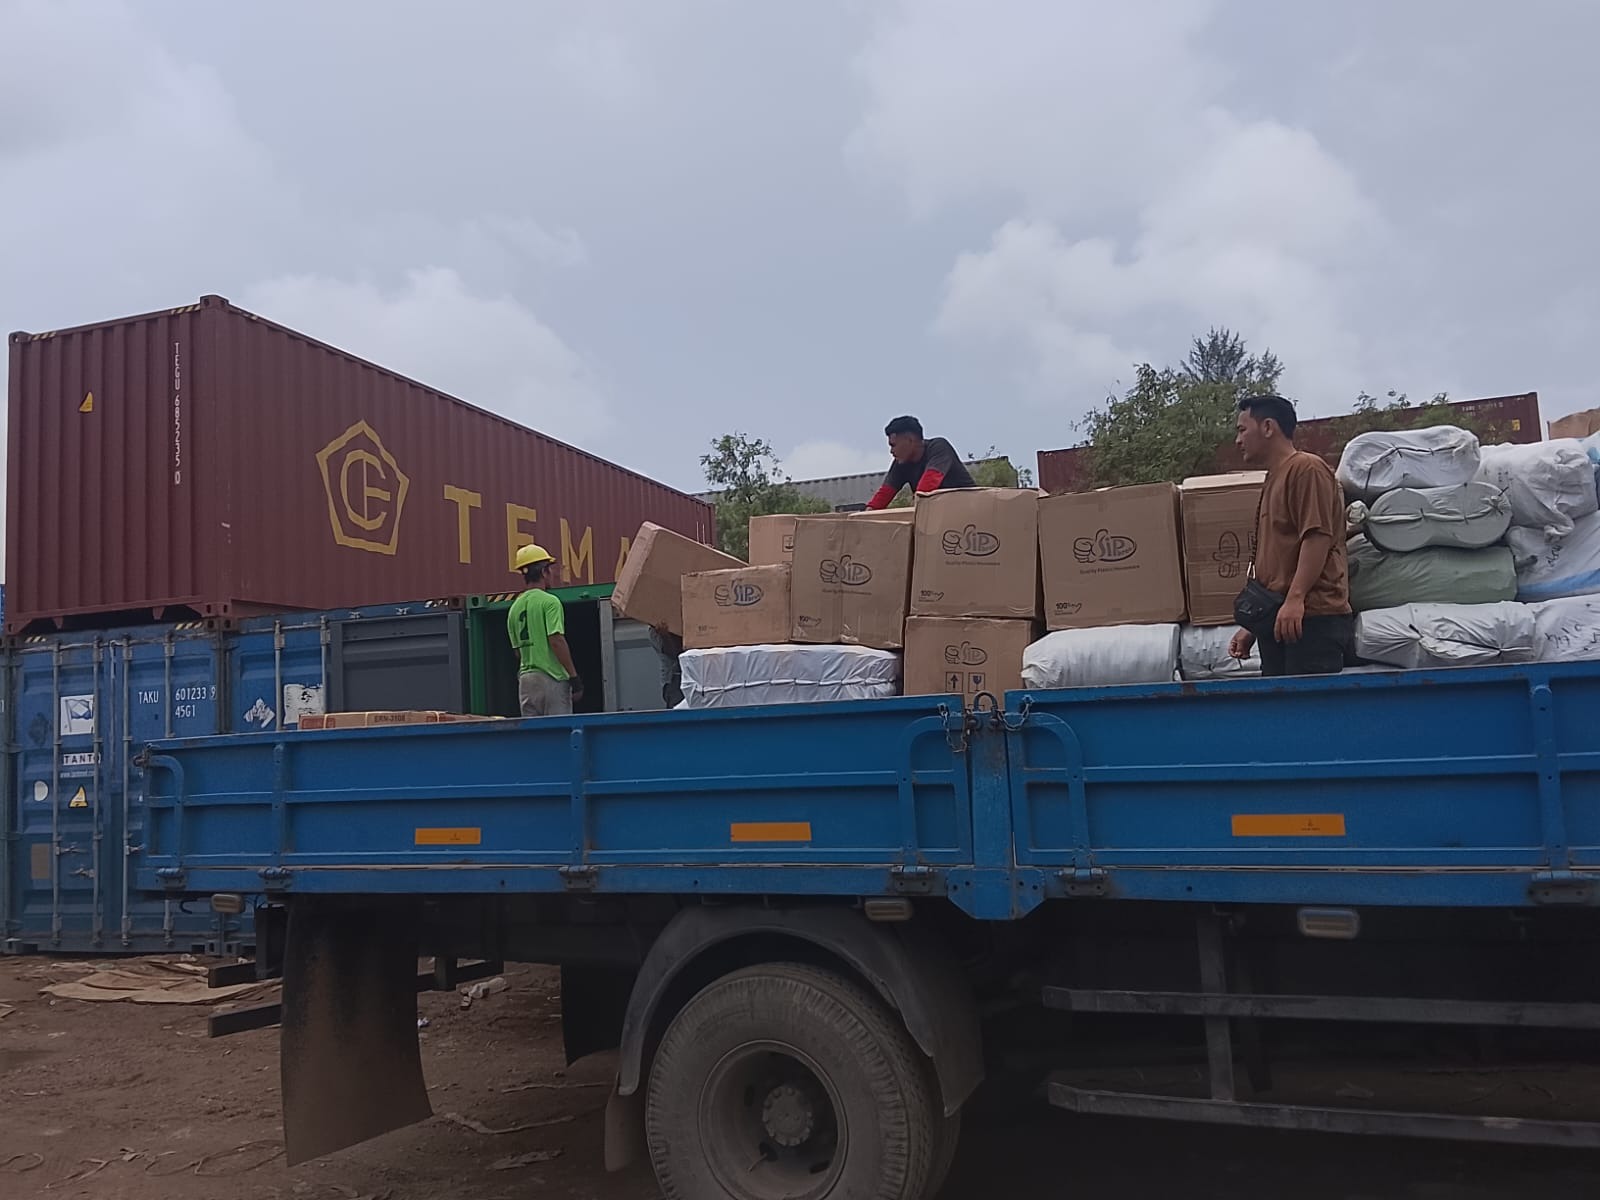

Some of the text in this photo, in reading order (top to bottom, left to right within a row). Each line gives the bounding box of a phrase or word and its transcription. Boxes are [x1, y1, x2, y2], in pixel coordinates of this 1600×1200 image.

[174, 471, 181, 485] 0
[138, 690, 159, 705] TAKU
[175, 686, 207, 701] 601233
[175, 704, 196, 719] 45G1
